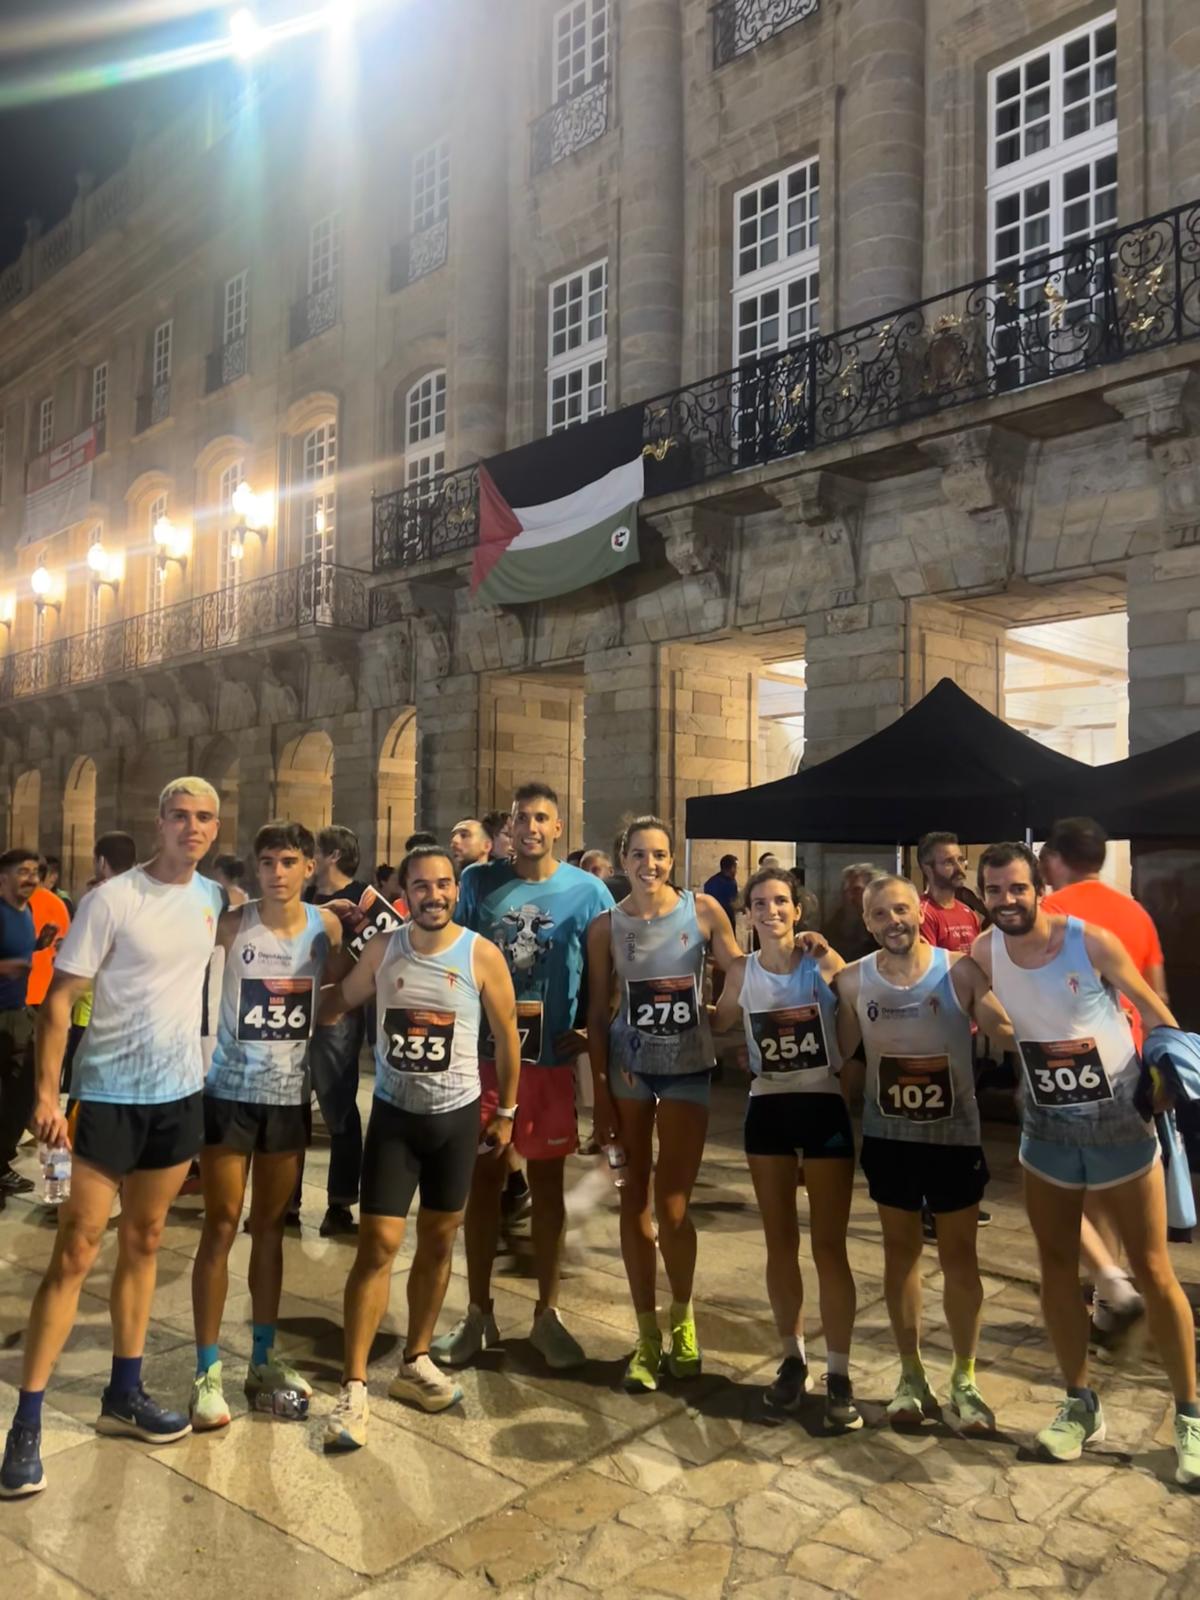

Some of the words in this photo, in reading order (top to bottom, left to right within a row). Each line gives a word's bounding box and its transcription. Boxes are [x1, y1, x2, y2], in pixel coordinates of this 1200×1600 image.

[243, 1004, 306, 1029] 436
[637, 1001, 691, 1026] 278
[391, 1033, 446, 1061] 233
[760, 1032, 820, 1061] 254
[1034, 1064, 1101, 1093] 306
[887, 1084, 945, 1109] 102
